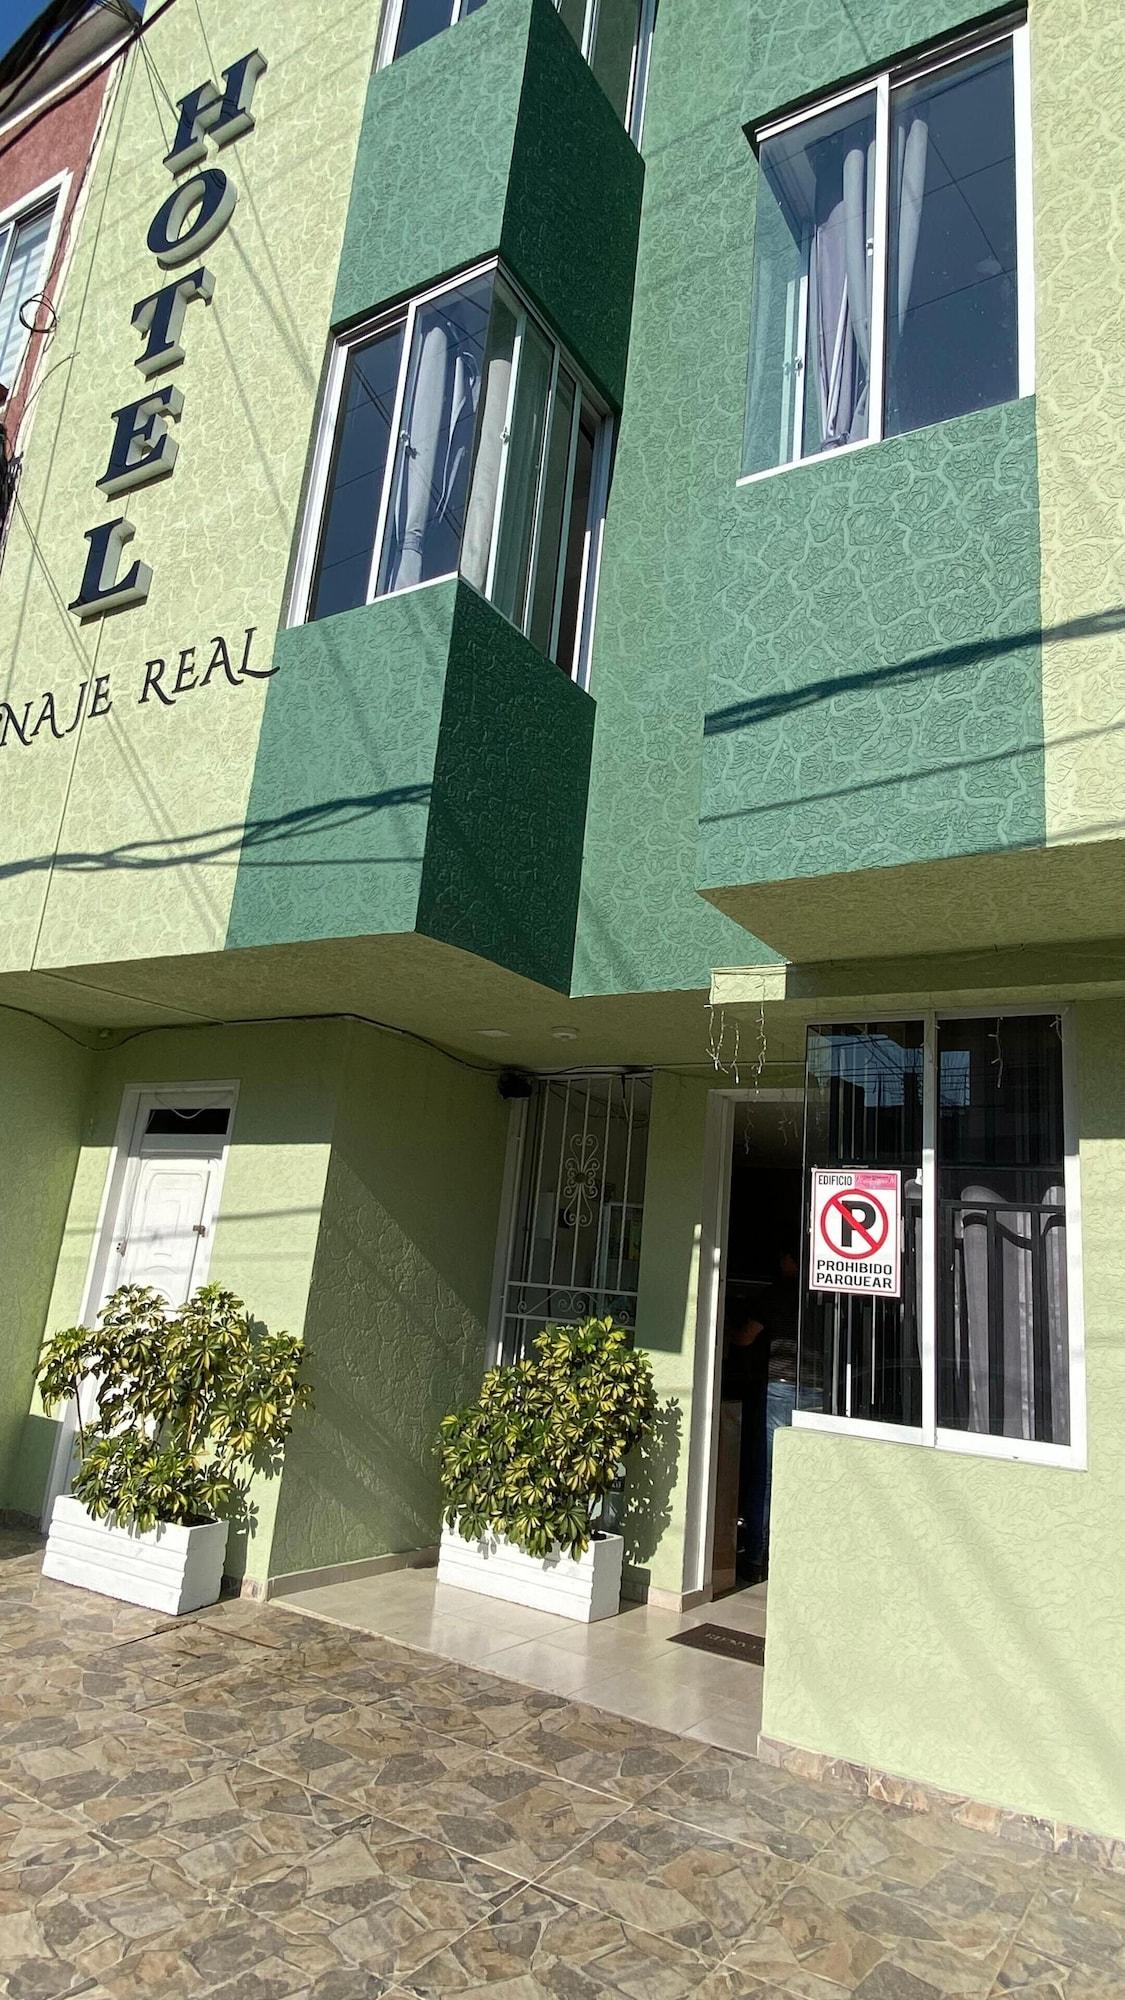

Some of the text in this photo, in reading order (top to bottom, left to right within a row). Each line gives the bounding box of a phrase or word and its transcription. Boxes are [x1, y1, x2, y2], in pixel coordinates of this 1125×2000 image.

[67, 47, 267, 619] HOTEL
[0, 626, 281, 747] NAJE REAL
[818, 1174, 853, 1186] EDIFICIO
[817, 1259, 893, 1276] PROHIBIDO
[816, 1272, 893, 1289] PARQUEAR
